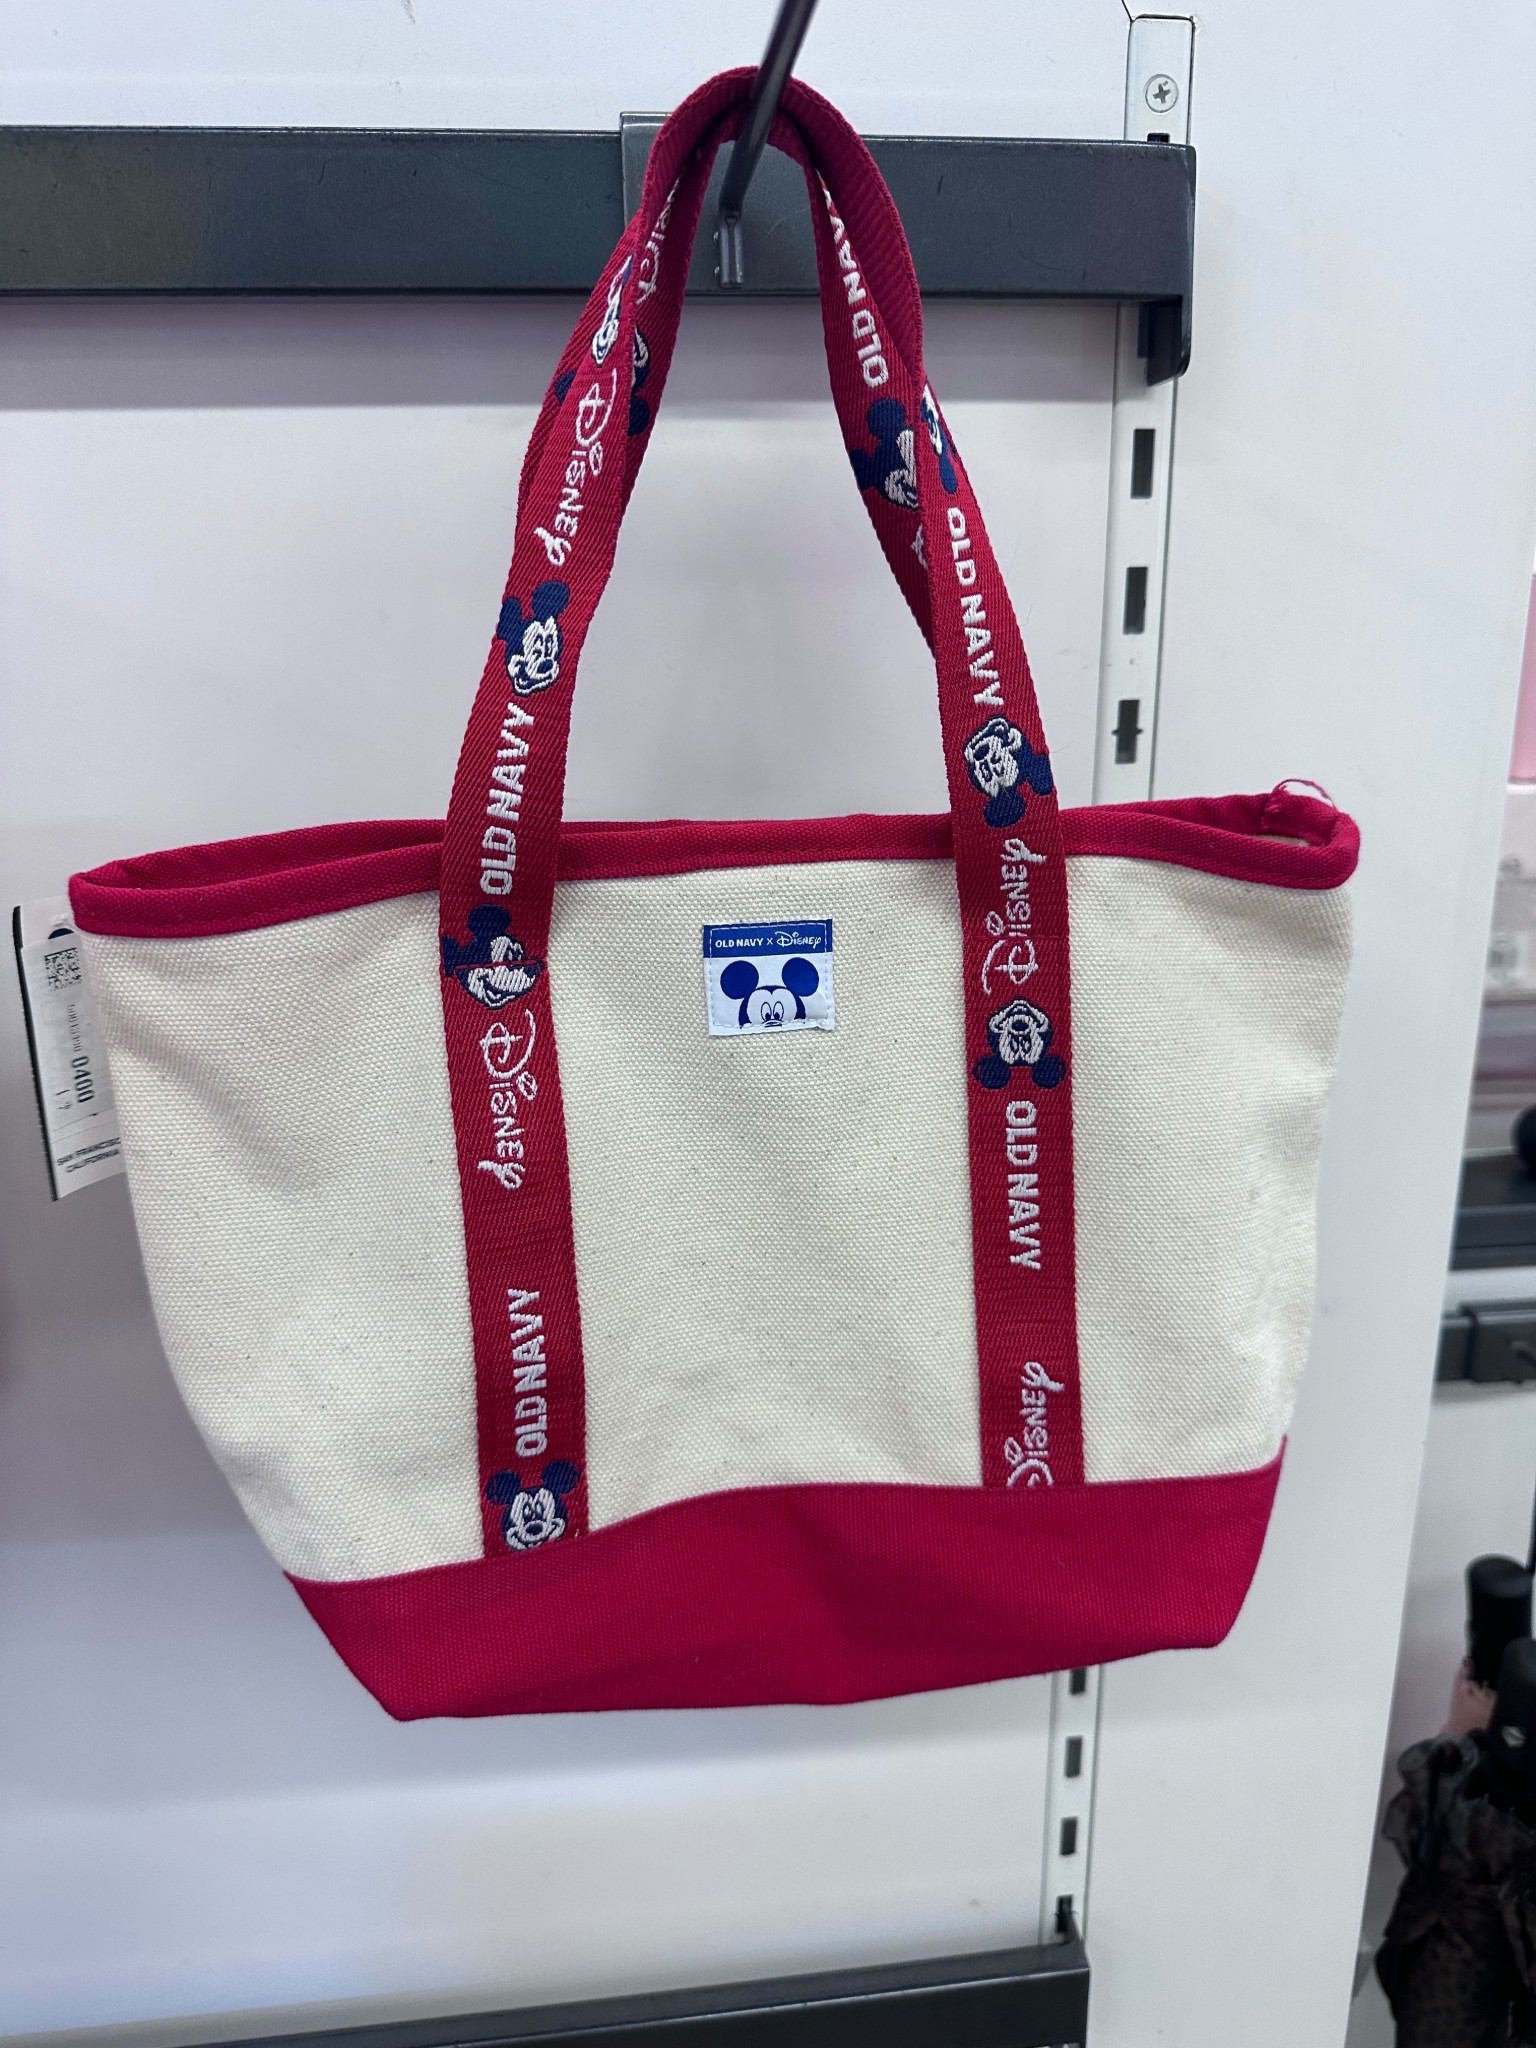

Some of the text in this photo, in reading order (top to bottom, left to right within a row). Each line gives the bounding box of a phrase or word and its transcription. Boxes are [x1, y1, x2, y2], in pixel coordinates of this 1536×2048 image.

[852, 308, 890, 389] OLD
[947, 506, 1005, 707] OLD NAVY
[479, 701, 536, 896] OLD NAVY
[715, 939, 734, 947] OLD
[736, 938, 763, 946] NAVY
[1005, 1100, 1042, 1271] OLD NAVY
[507, 1288, 549, 1458] OLD NAVY
